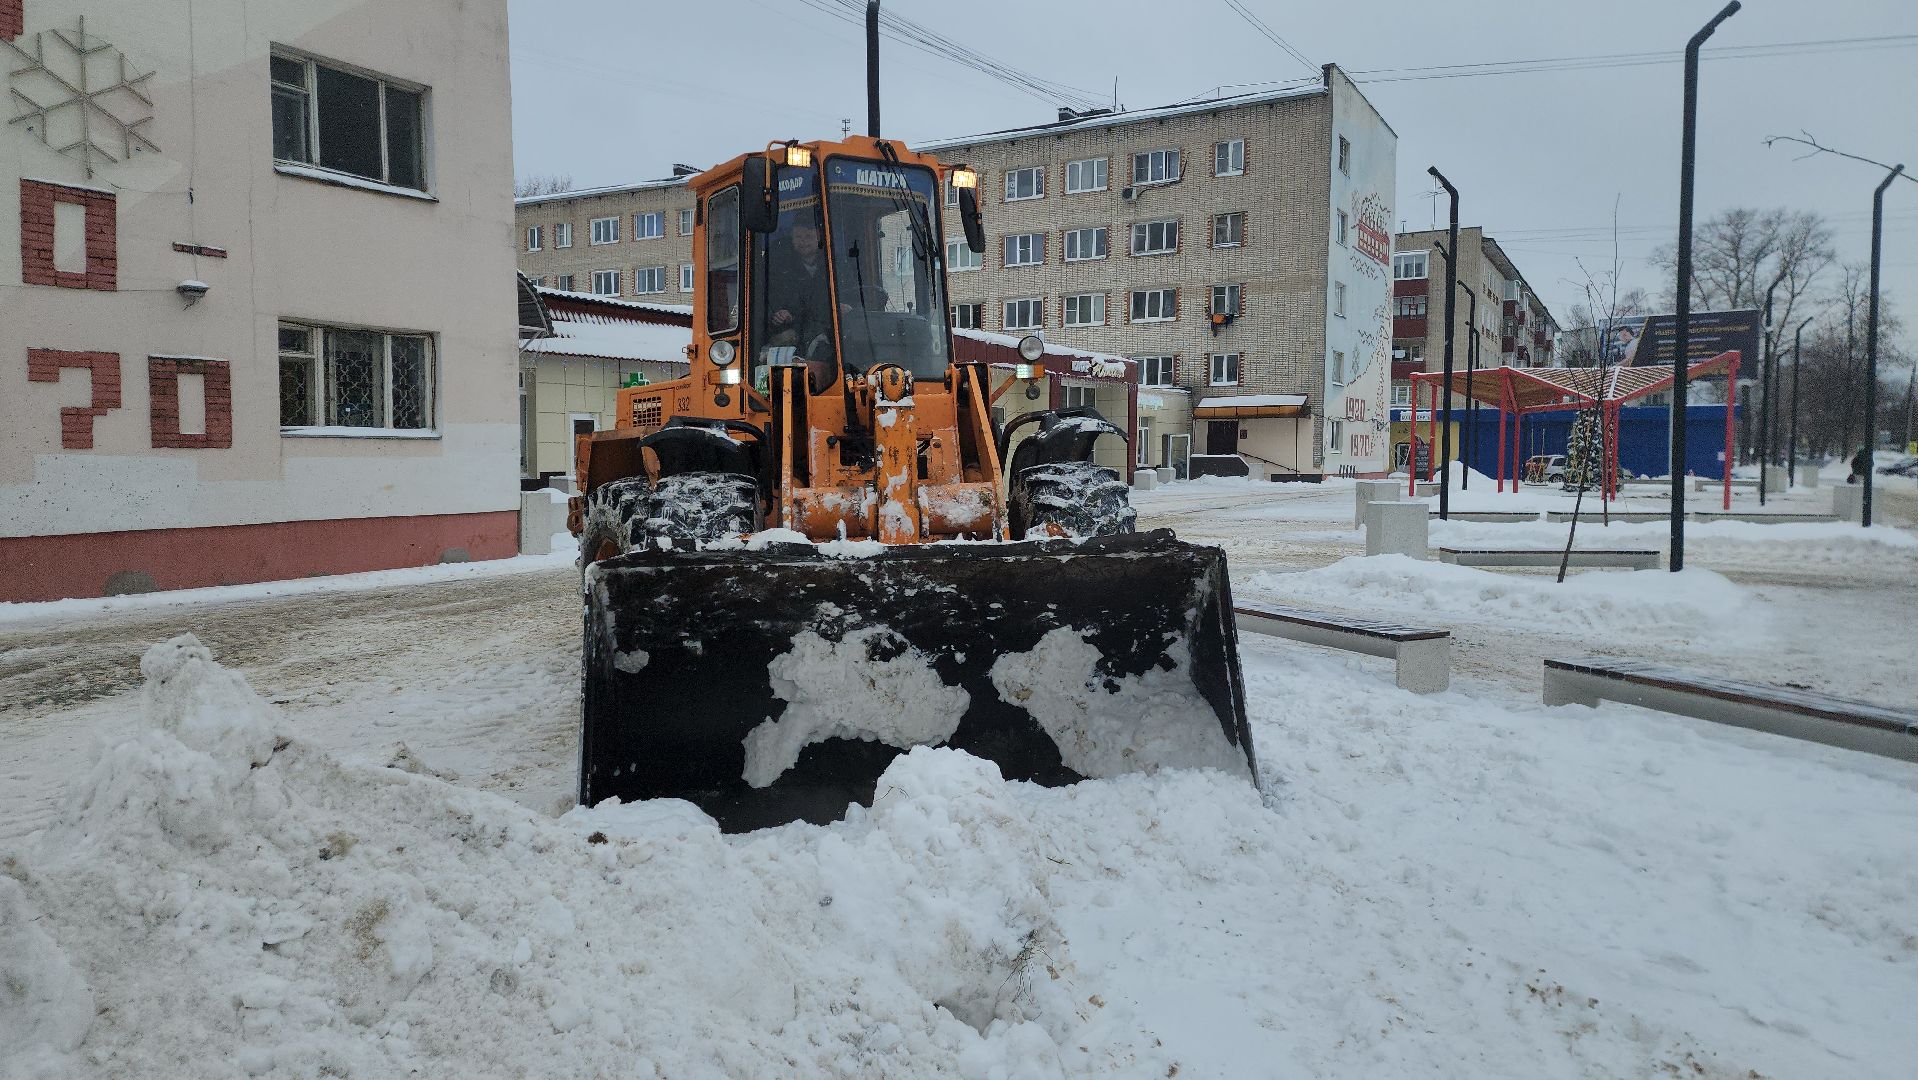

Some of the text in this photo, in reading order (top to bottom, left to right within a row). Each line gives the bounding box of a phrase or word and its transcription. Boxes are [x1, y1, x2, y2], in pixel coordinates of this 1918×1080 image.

[856, 168, 907, 189] ШАТУРА
[677, 396, 690, 412] 332
[1345, 396, 1366, 421] 1920
[1350, 433, 1370, 457] 1970
